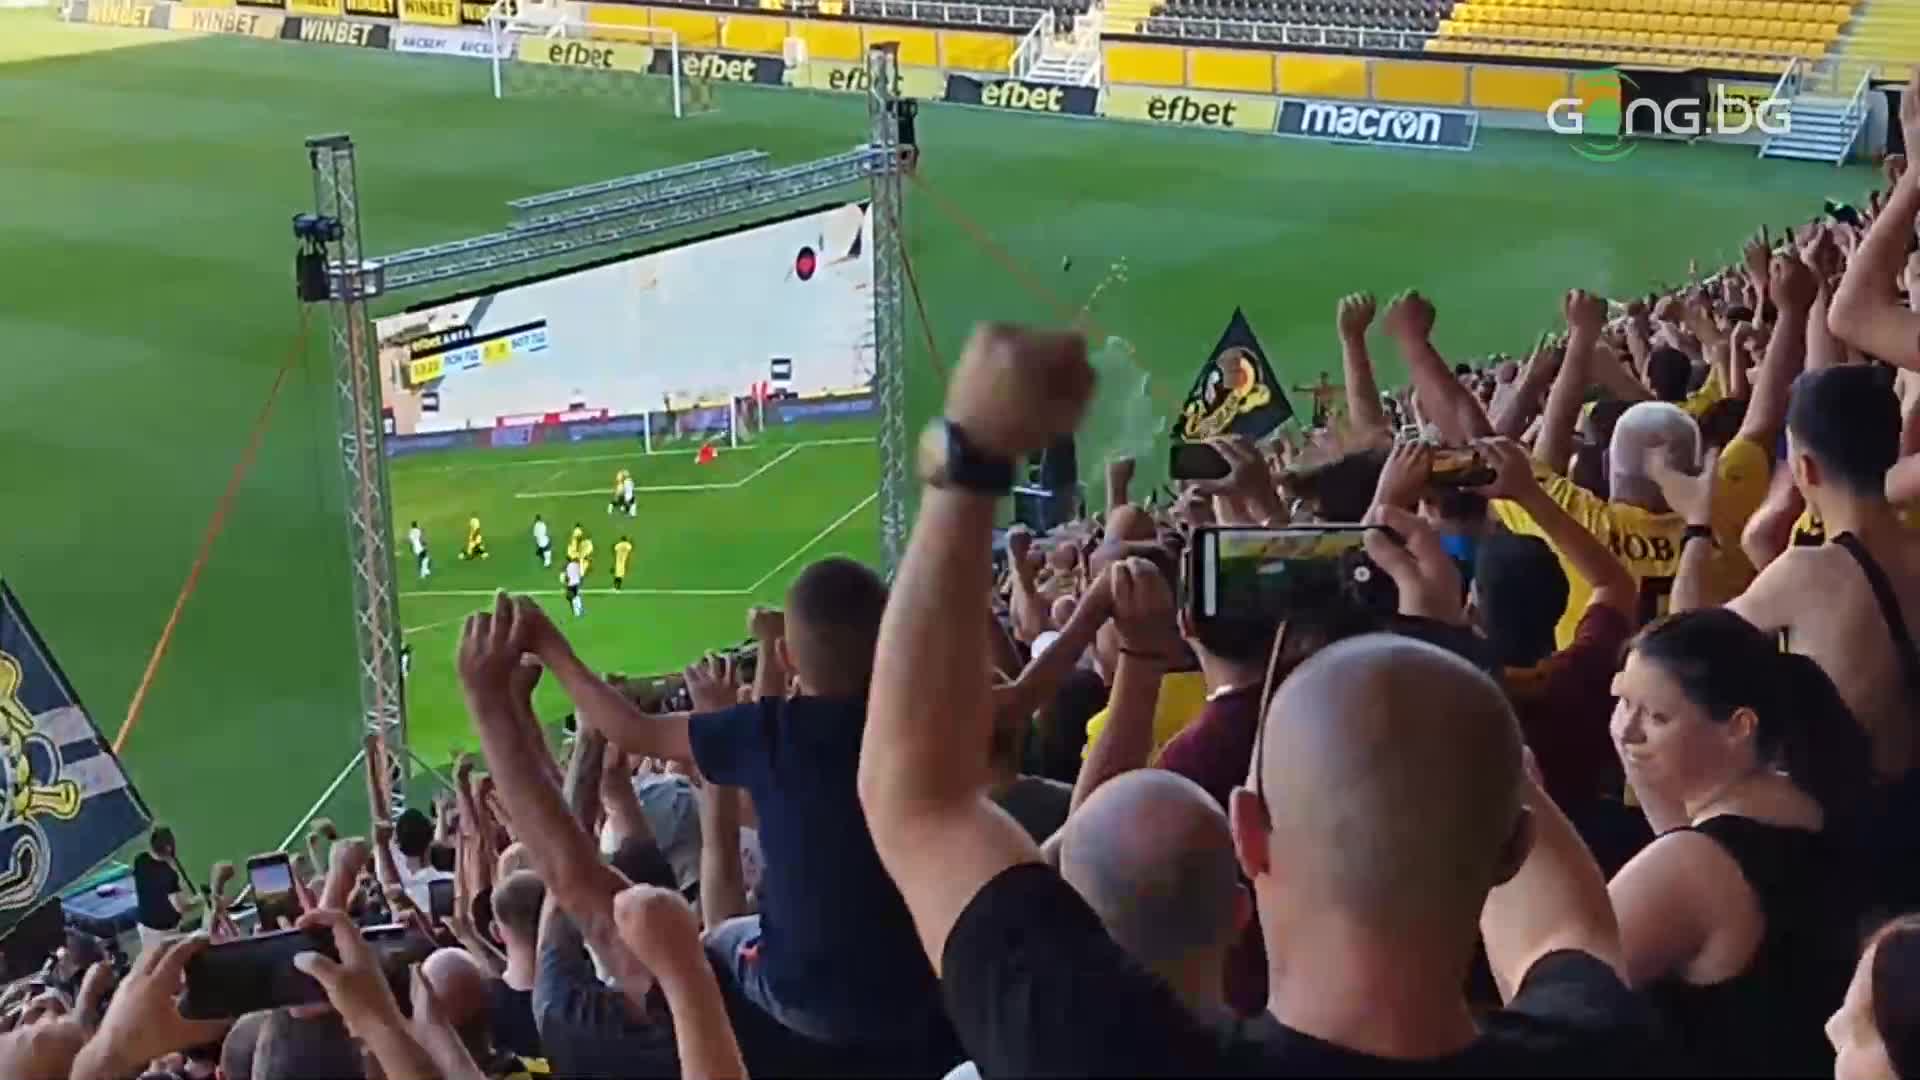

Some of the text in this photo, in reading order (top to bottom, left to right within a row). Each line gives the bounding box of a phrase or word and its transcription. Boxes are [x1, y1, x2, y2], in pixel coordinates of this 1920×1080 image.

[192, 11, 260, 33] WINBET
[404, 0, 454, 18] WINBET
[300, 18, 373, 46] WINBET
[549, 42, 614, 67] efbet
[682, 53, 756, 81] efbet
[828, 67, 903, 96] efbt
[981, 79, 1064, 112] efbet
[1147, 97, 1237, 127] efbet
[1300, 103, 1441, 142] macron
